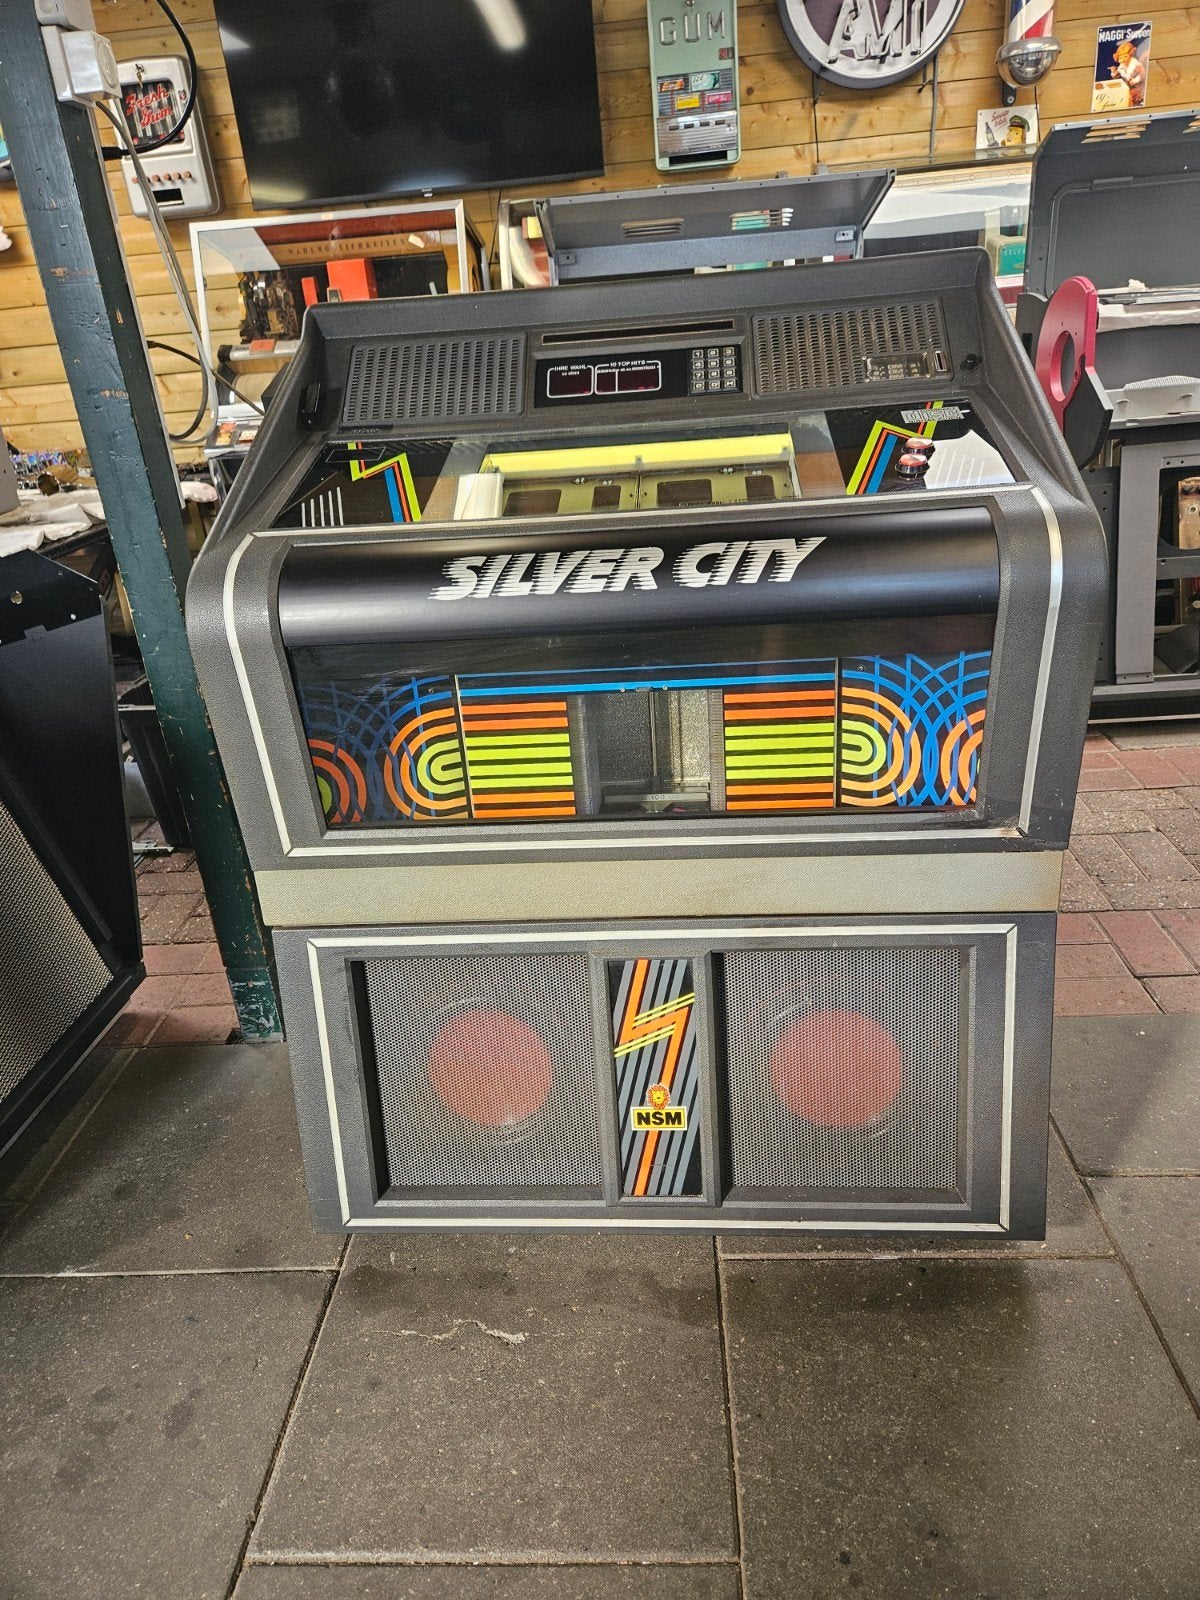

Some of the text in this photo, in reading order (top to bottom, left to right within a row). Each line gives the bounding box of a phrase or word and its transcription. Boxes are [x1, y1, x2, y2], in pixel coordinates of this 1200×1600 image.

[659, 9, 726, 46] GUM
[126, 84, 169, 116] Fresh
[141, 107, 173, 127] Gum
[427, 536, 828, 600] SILVER CITY
[637, 1111, 682, 1126] NSM
